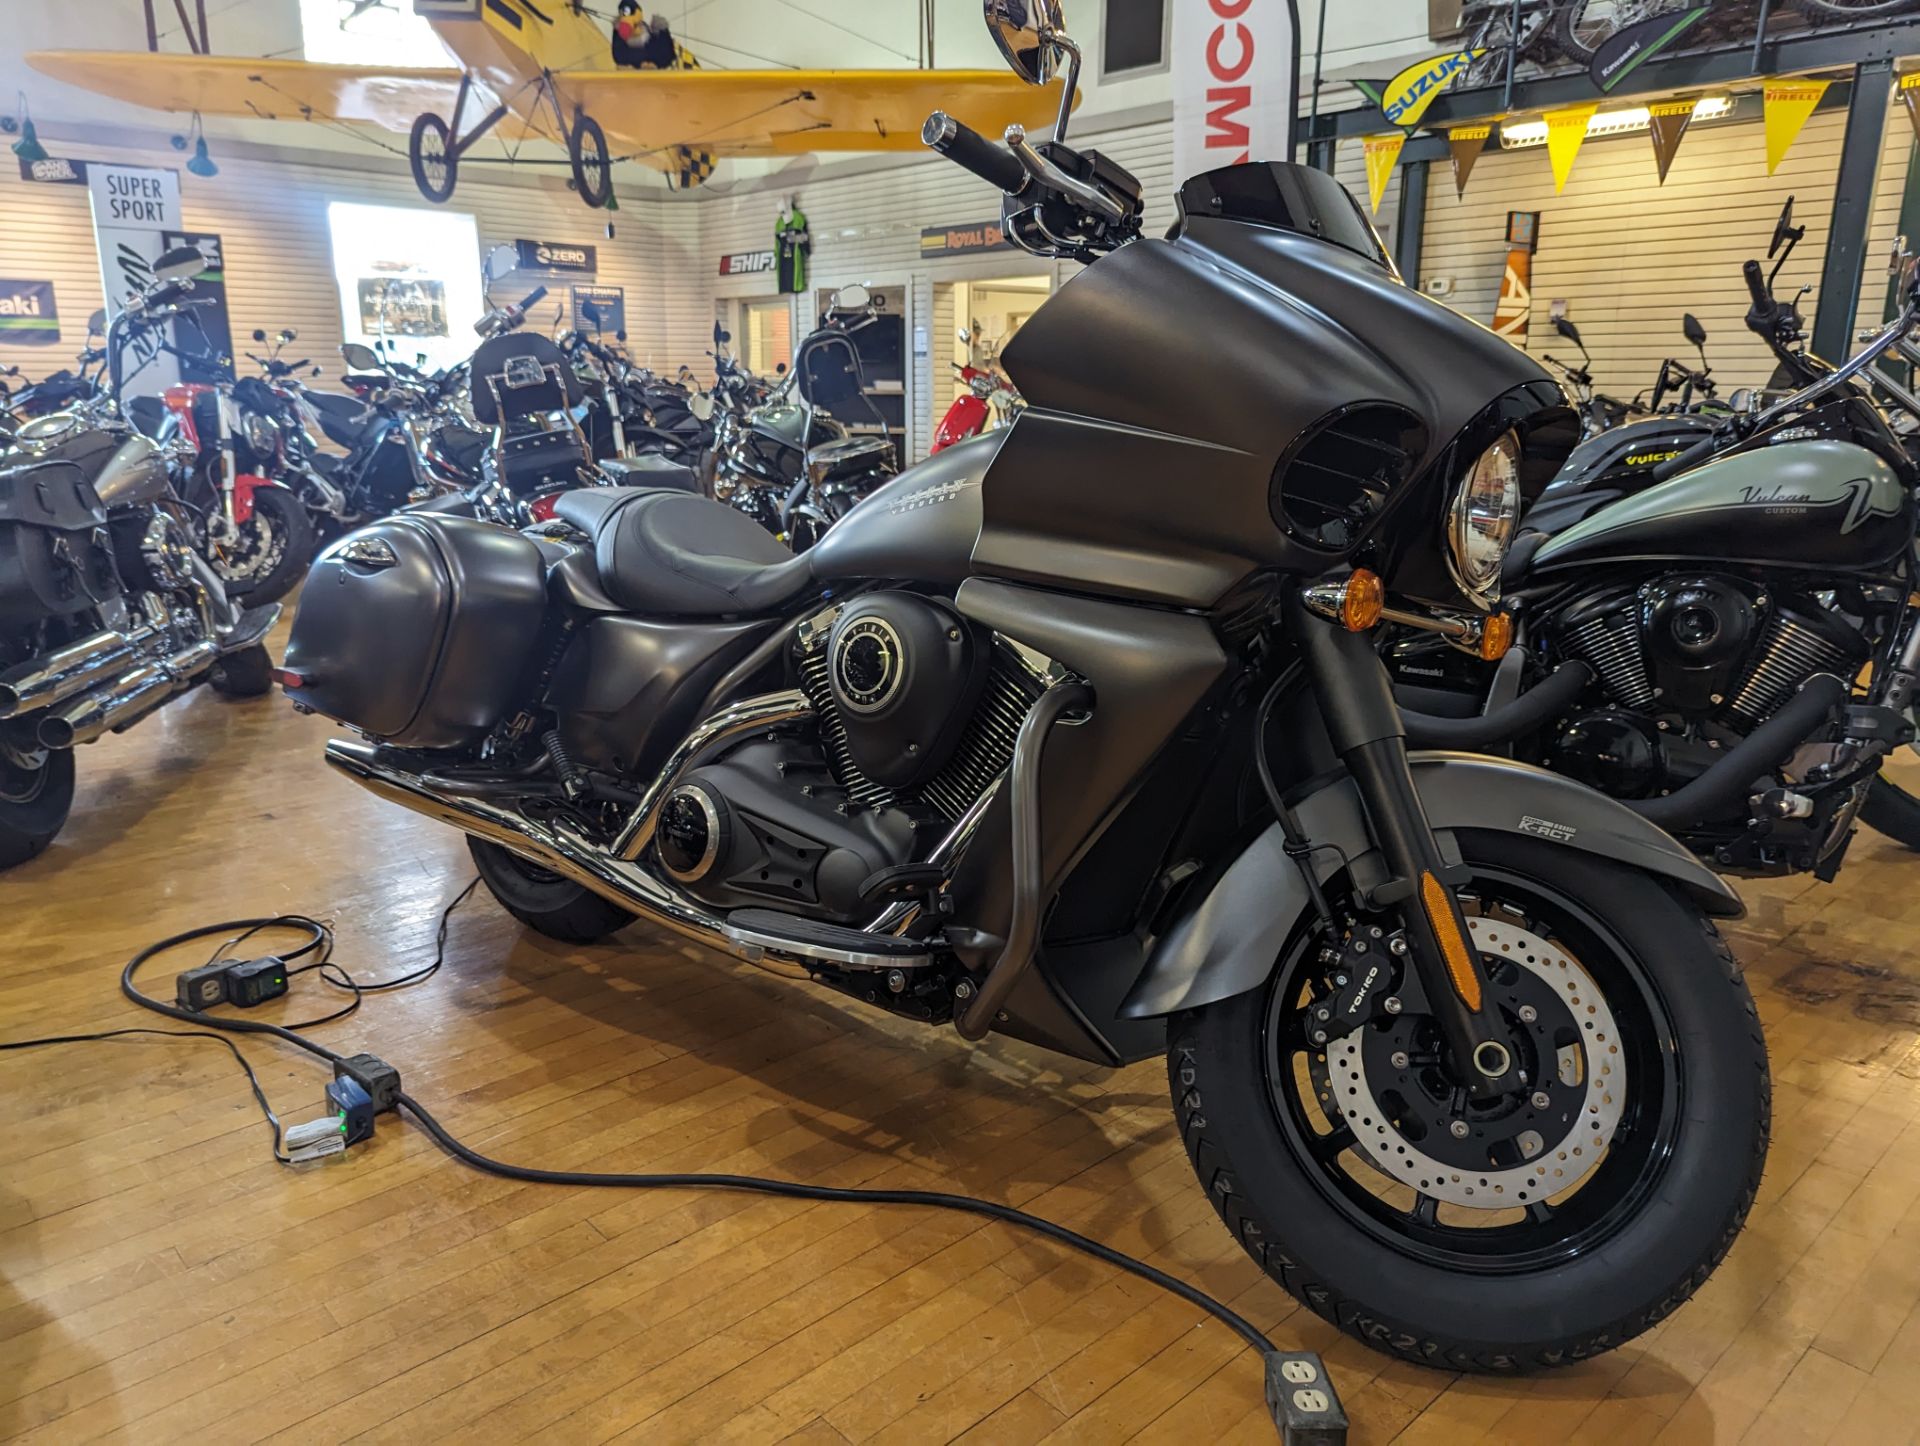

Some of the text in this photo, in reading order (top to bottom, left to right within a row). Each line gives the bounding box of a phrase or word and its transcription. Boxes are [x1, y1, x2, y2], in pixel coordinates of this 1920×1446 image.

[1601, 41, 1641, 77] Kawasaki
[1384, 50, 1475, 123] SUZUKI
[106, 174, 163, 198] SUPER
[110, 198, 165, 222] SPORT
[947, 230, 984, 248] ROYAL
[552, 249, 586, 263] ZERO
[1625, 451, 1684, 466] Vulca
[1739, 485, 1812, 503] Vulcan
[1765, 506, 1807, 514] CUSTOM
[1399, 664, 1444, 677] Kawasaki
[1518, 820, 1574, 841] K-ACT
[1348, 966, 1378, 1014] TOKICO
